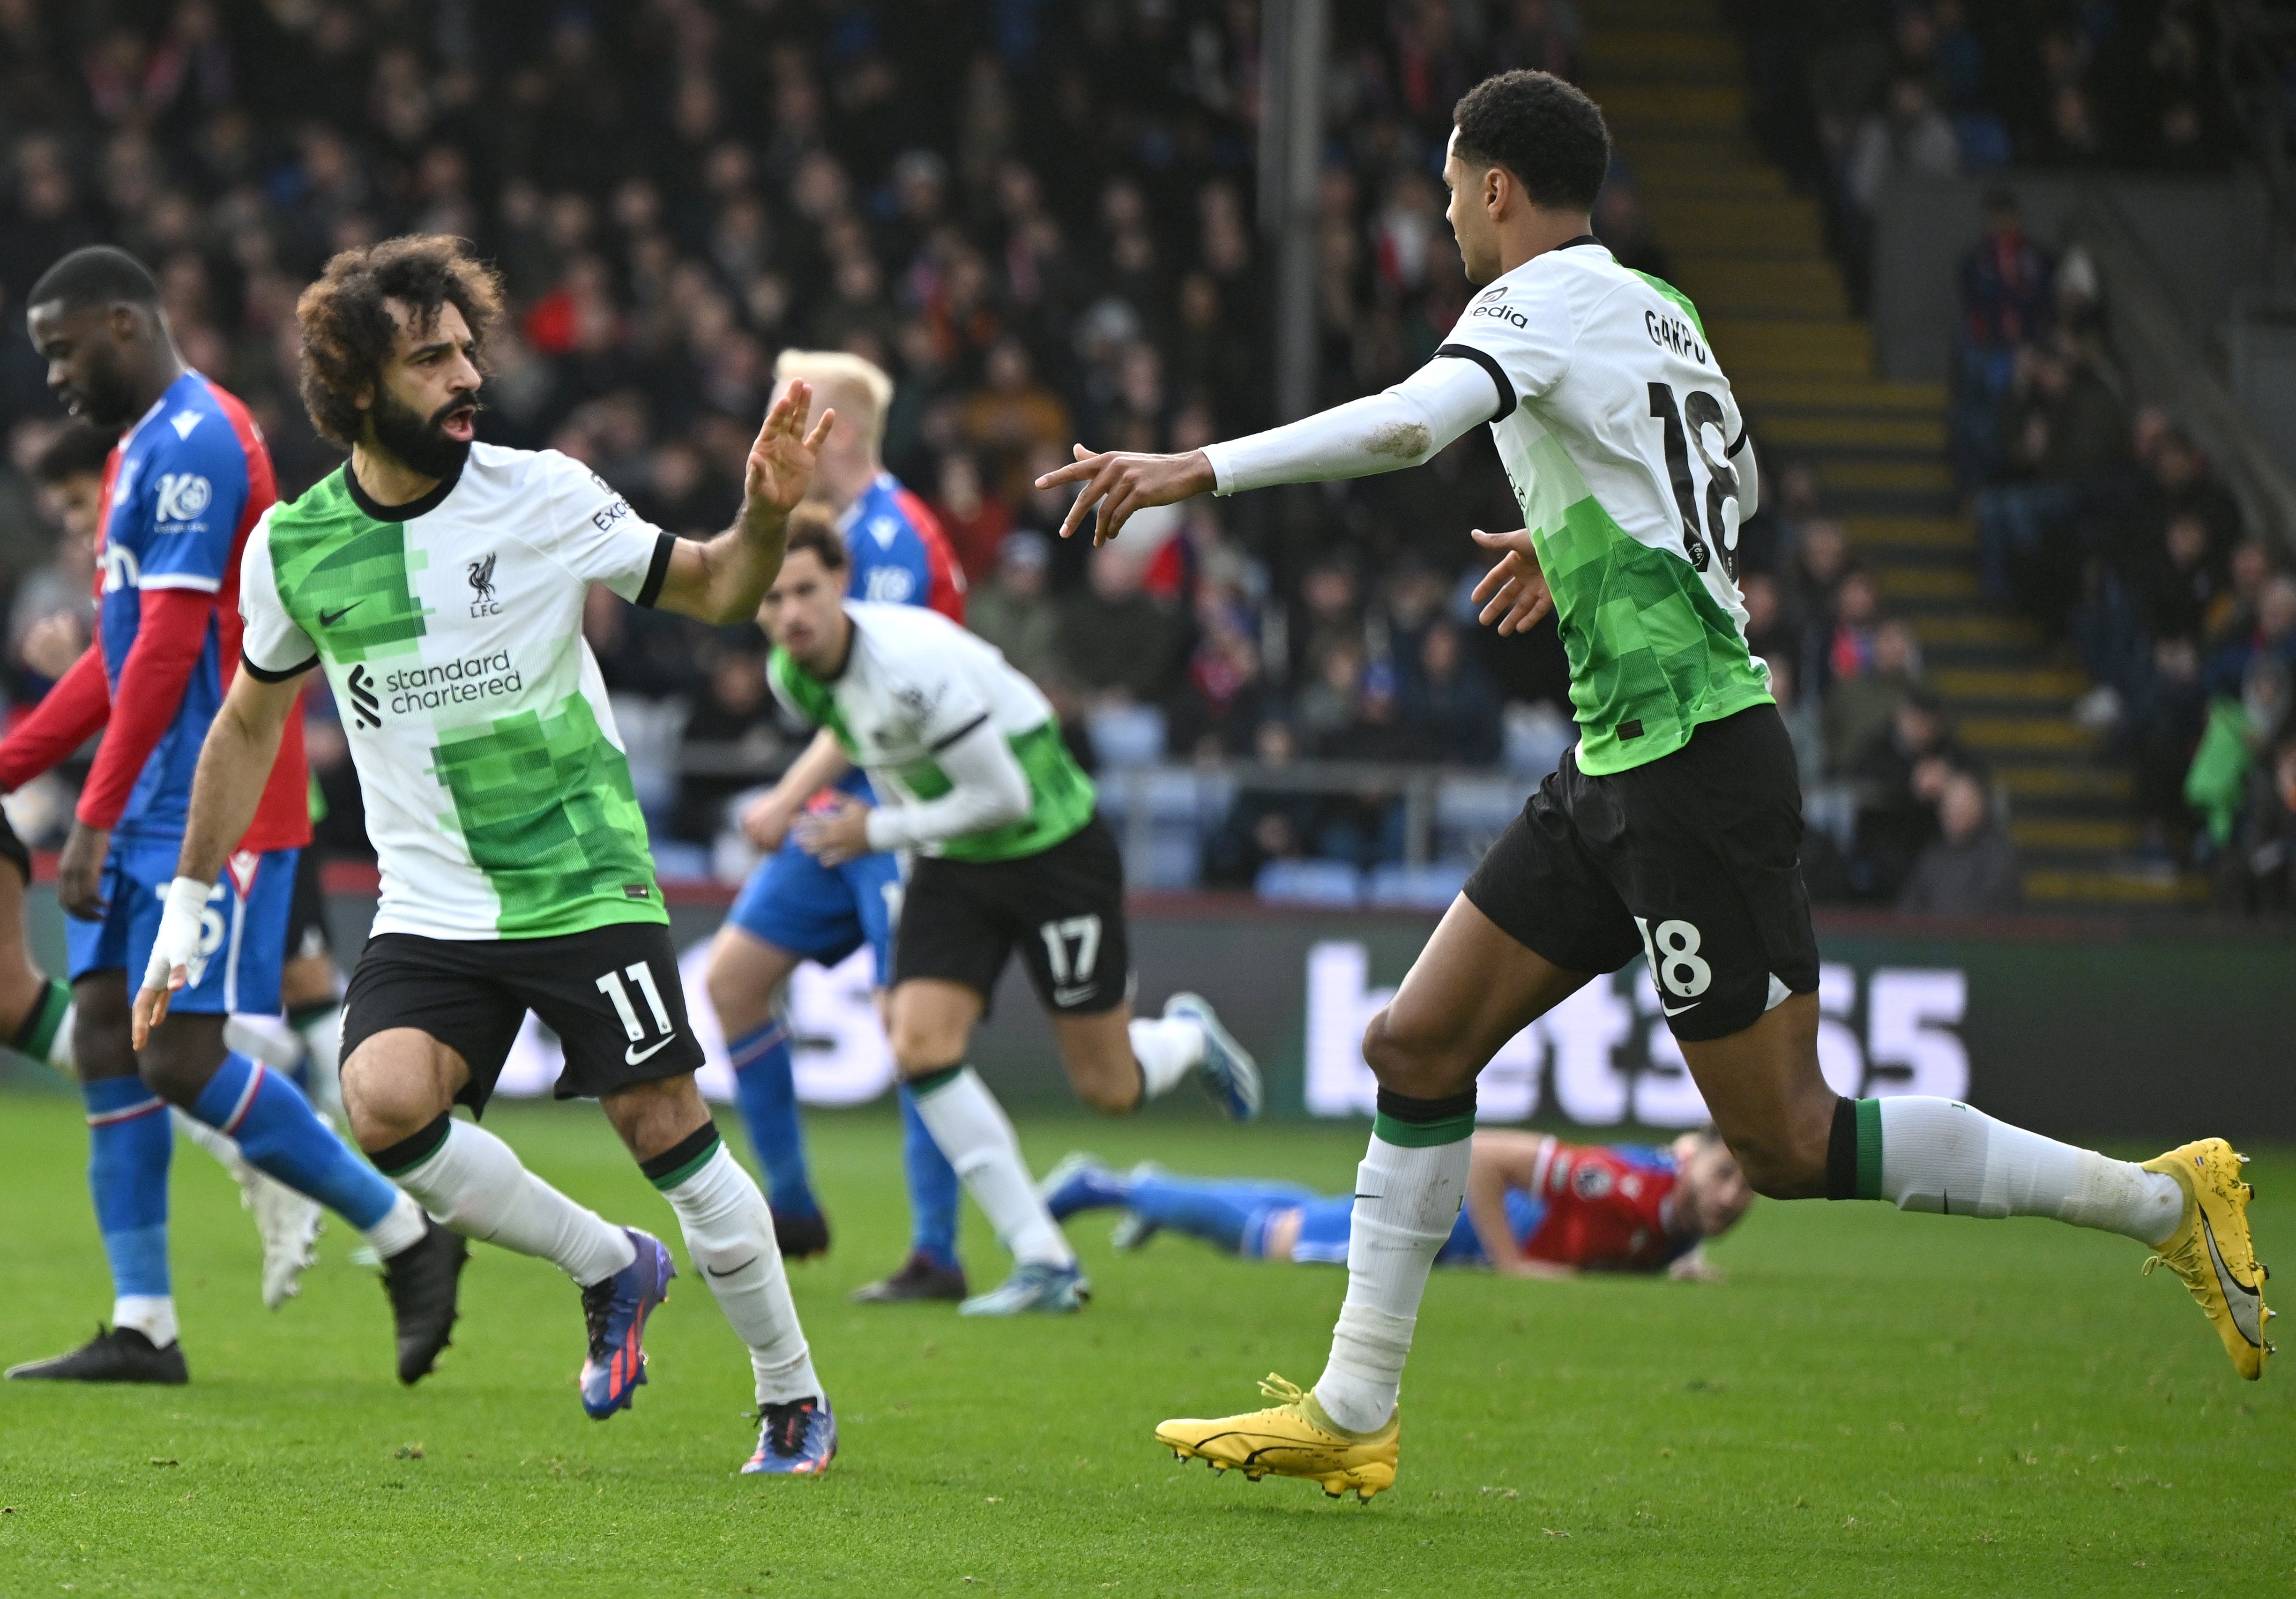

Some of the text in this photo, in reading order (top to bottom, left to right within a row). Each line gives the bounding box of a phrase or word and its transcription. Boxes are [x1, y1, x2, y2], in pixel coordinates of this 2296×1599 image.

[1465, 305, 1528, 329] edia
[1645, 310, 1706, 365] GAKPO
[1647, 382, 1739, 585] 18
[386, 649, 511, 693] standard
[391, 671, 522, 714] chartered
[1040, 915, 1102, 983] 17
[1633, 915, 1712, 997] 18
[595, 961, 673, 1042] 11
